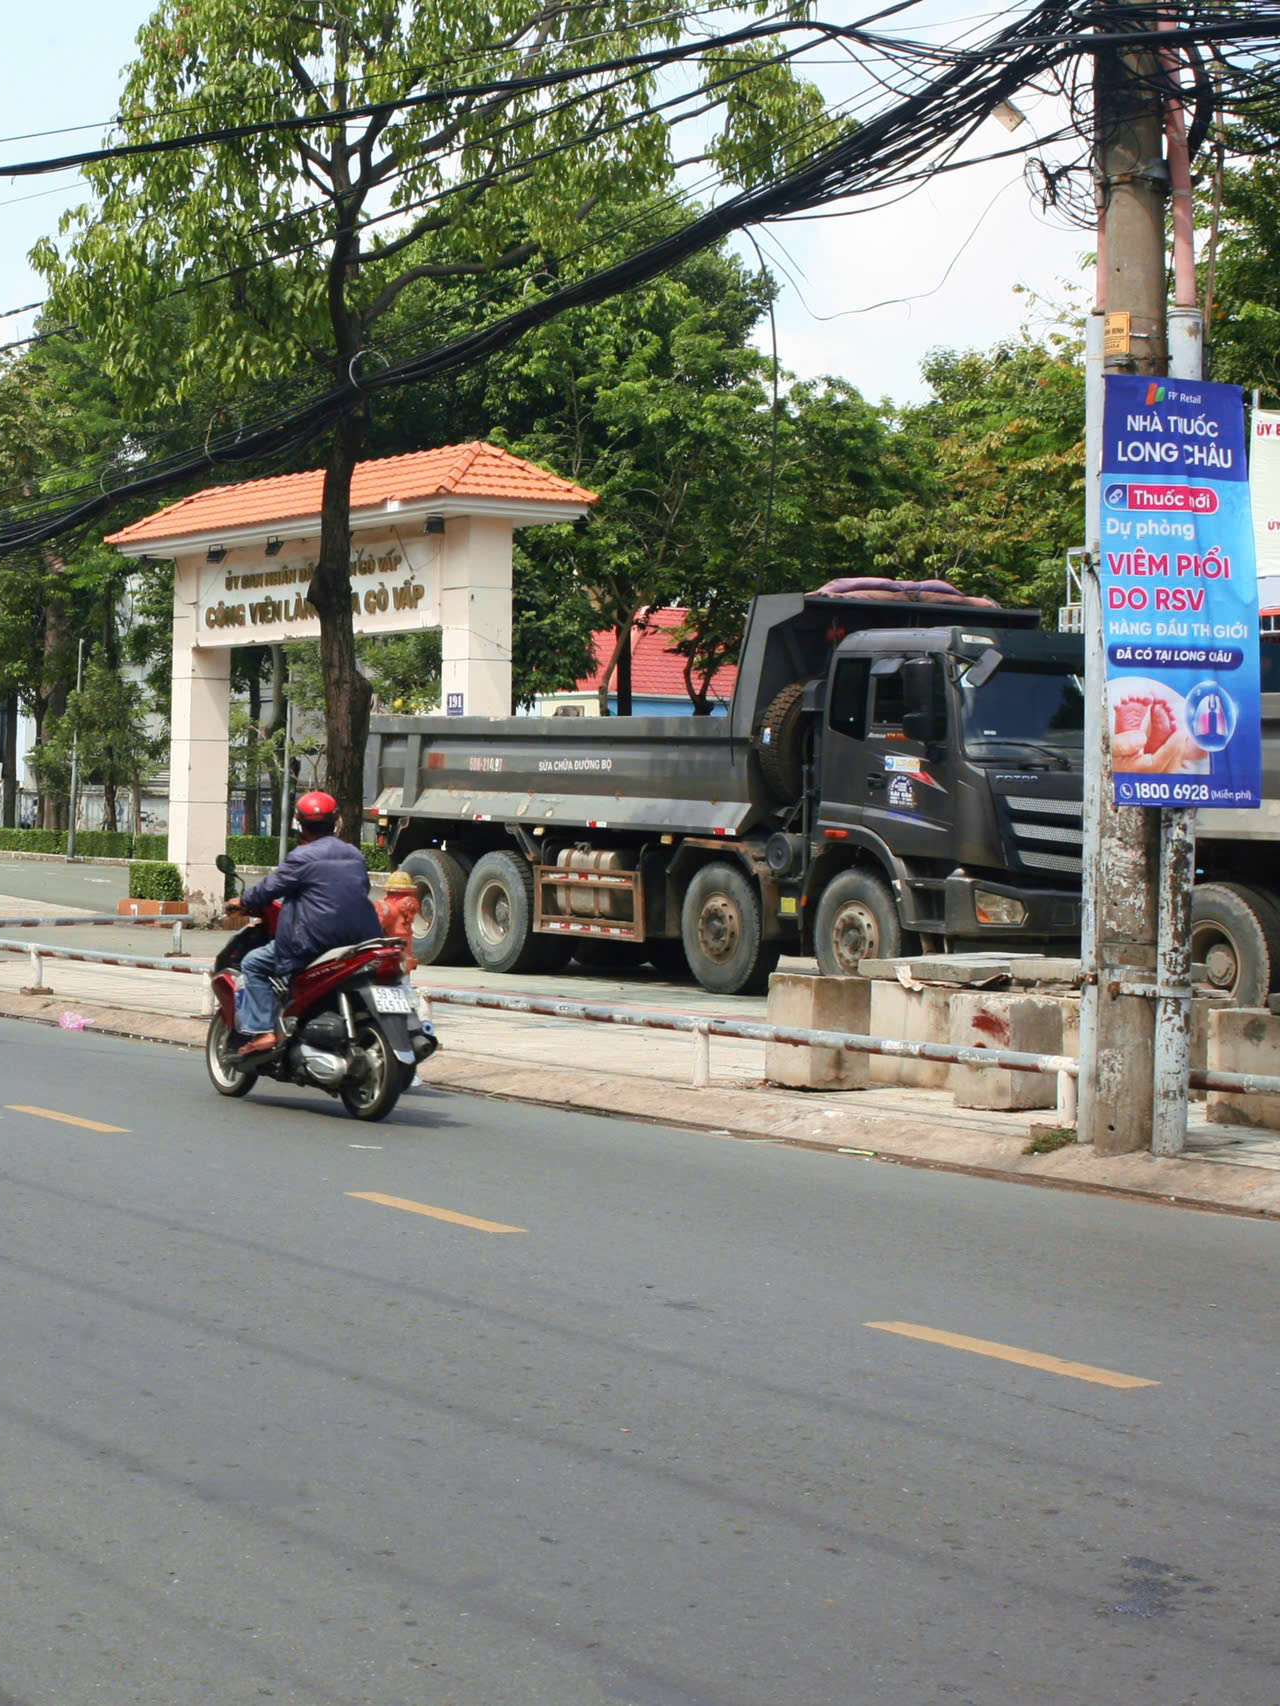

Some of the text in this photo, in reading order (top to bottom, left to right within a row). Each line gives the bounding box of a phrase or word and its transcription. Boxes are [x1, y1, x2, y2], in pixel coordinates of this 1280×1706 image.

[1180, 392, 1201, 404] Retail
[1127, 411, 1163, 432] NHÀ
[1117, 441, 1232, 469] LONG CHÂU
[1133, 489, 1185, 506] Thuốc
[1106, 518, 1195, 541] Dự phòng
[1107, 546, 1170, 577] VIÊM
[206, 600, 246, 629] CÔNG
[249, 595, 283, 625] VIÊN
[364, 581, 389, 615] GÒ
[392, 575, 425, 611] VẤP
[1107, 586, 1205, 612] DO RSV
[1109, 618, 1152, 636] HÀNG
[1156, 618, 1188, 637] ĐẦU
[1213, 621, 1249, 639] GIỚI
[1116, 646, 1132, 660] ĐÃ
[1135, 647, 1152, 660] CÓ
[1155, 650, 1172, 663] TẠI
[1174, 650, 1206, 662] LONG
[448, 695, 462, 708] 191
[1134, 782, 1170, 799] 1800
[1173, 783, 1210, 801] 6928
